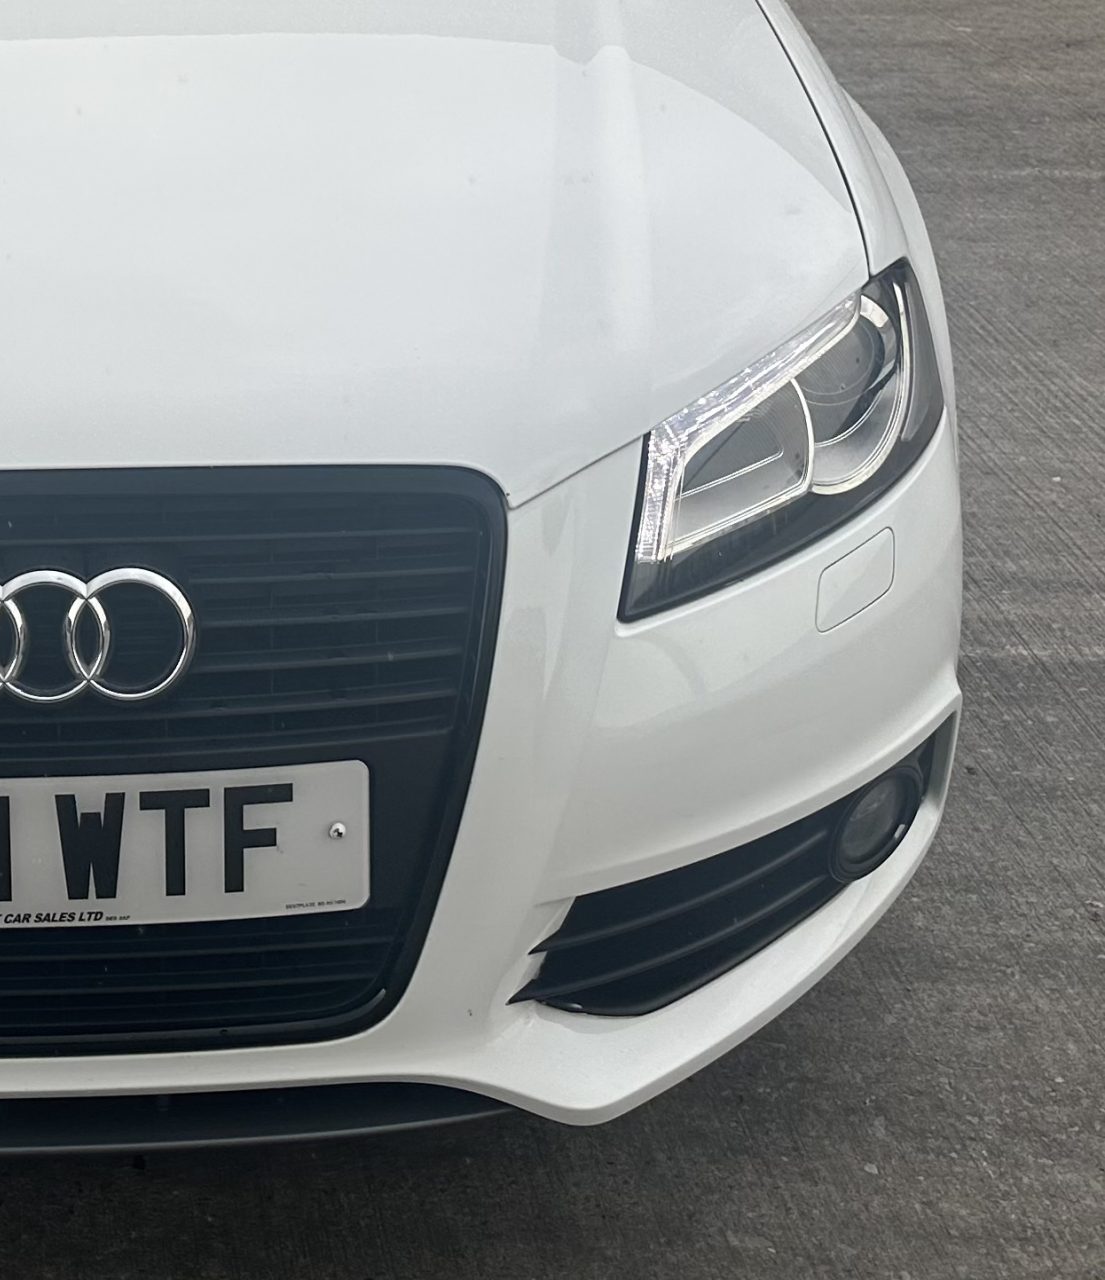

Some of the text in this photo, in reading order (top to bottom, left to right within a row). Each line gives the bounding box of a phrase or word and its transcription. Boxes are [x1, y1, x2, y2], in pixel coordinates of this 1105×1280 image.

[54, 782, 294, 901] WTF
[3, 913, 32, 924] CAR
[34, 911, 76, 923] SALES
[78, 911, 104, 922] LTD
